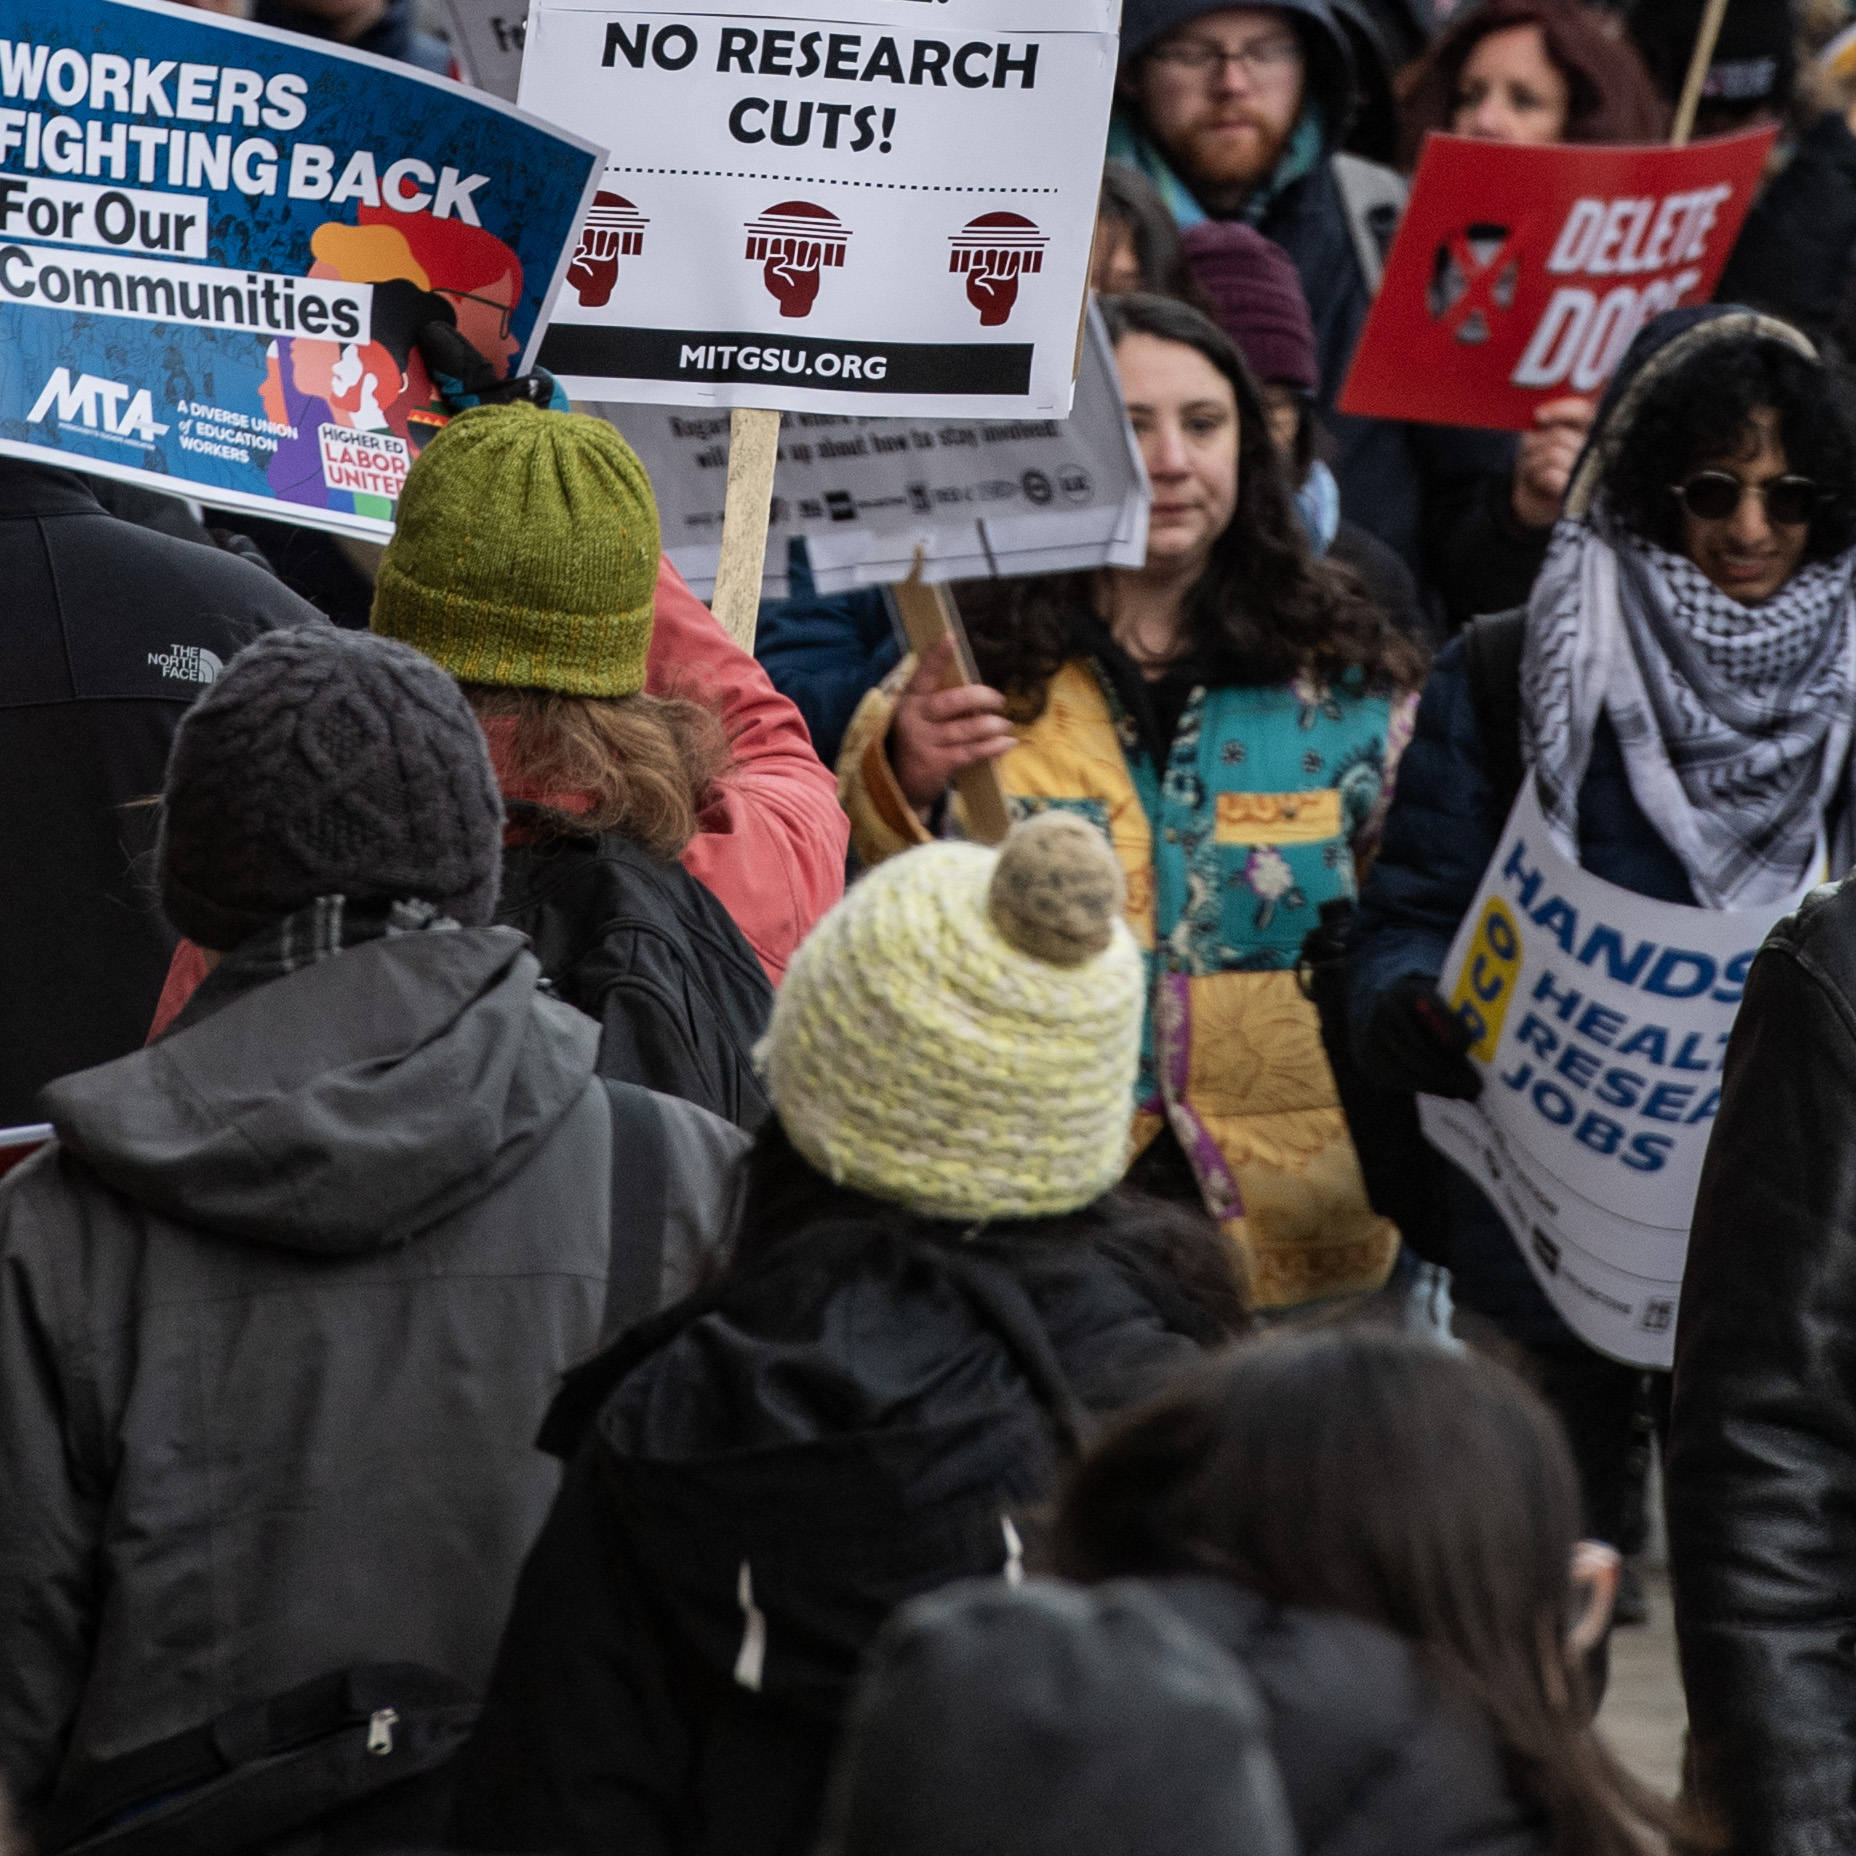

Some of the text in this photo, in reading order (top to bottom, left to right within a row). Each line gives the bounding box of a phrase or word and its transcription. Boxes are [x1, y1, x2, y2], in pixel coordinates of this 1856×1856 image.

[601, 22, 1040, 90] NO RESEARCH
[728, 96, 896, 155] CUTS!
[287, 143, 491, 228] BACK
[95, 190, 196, 253] Our
[1546, 183, 1733, 275] DELETE
[1511, 270, 1701, 391] DO
[679, 344, 888, 380] MITGSU.ORG
[26, 366, 170, 441] MTA
[177, 399, 299, 441] A DIVERSE UNION
[179, 435, 250, 463] WORKERS
[195, 421, 279, 452] EDUCATION
[323, 427, 404, 455] HIGHER ED
[325, 442, 408, 476] LABOR
[147, 653, 199, 669] NORTH
[170, 644, 199, 658] THE
[162, 666, 199, 681] FACE
[1499, 1063, 1679, 1174] JOBS
